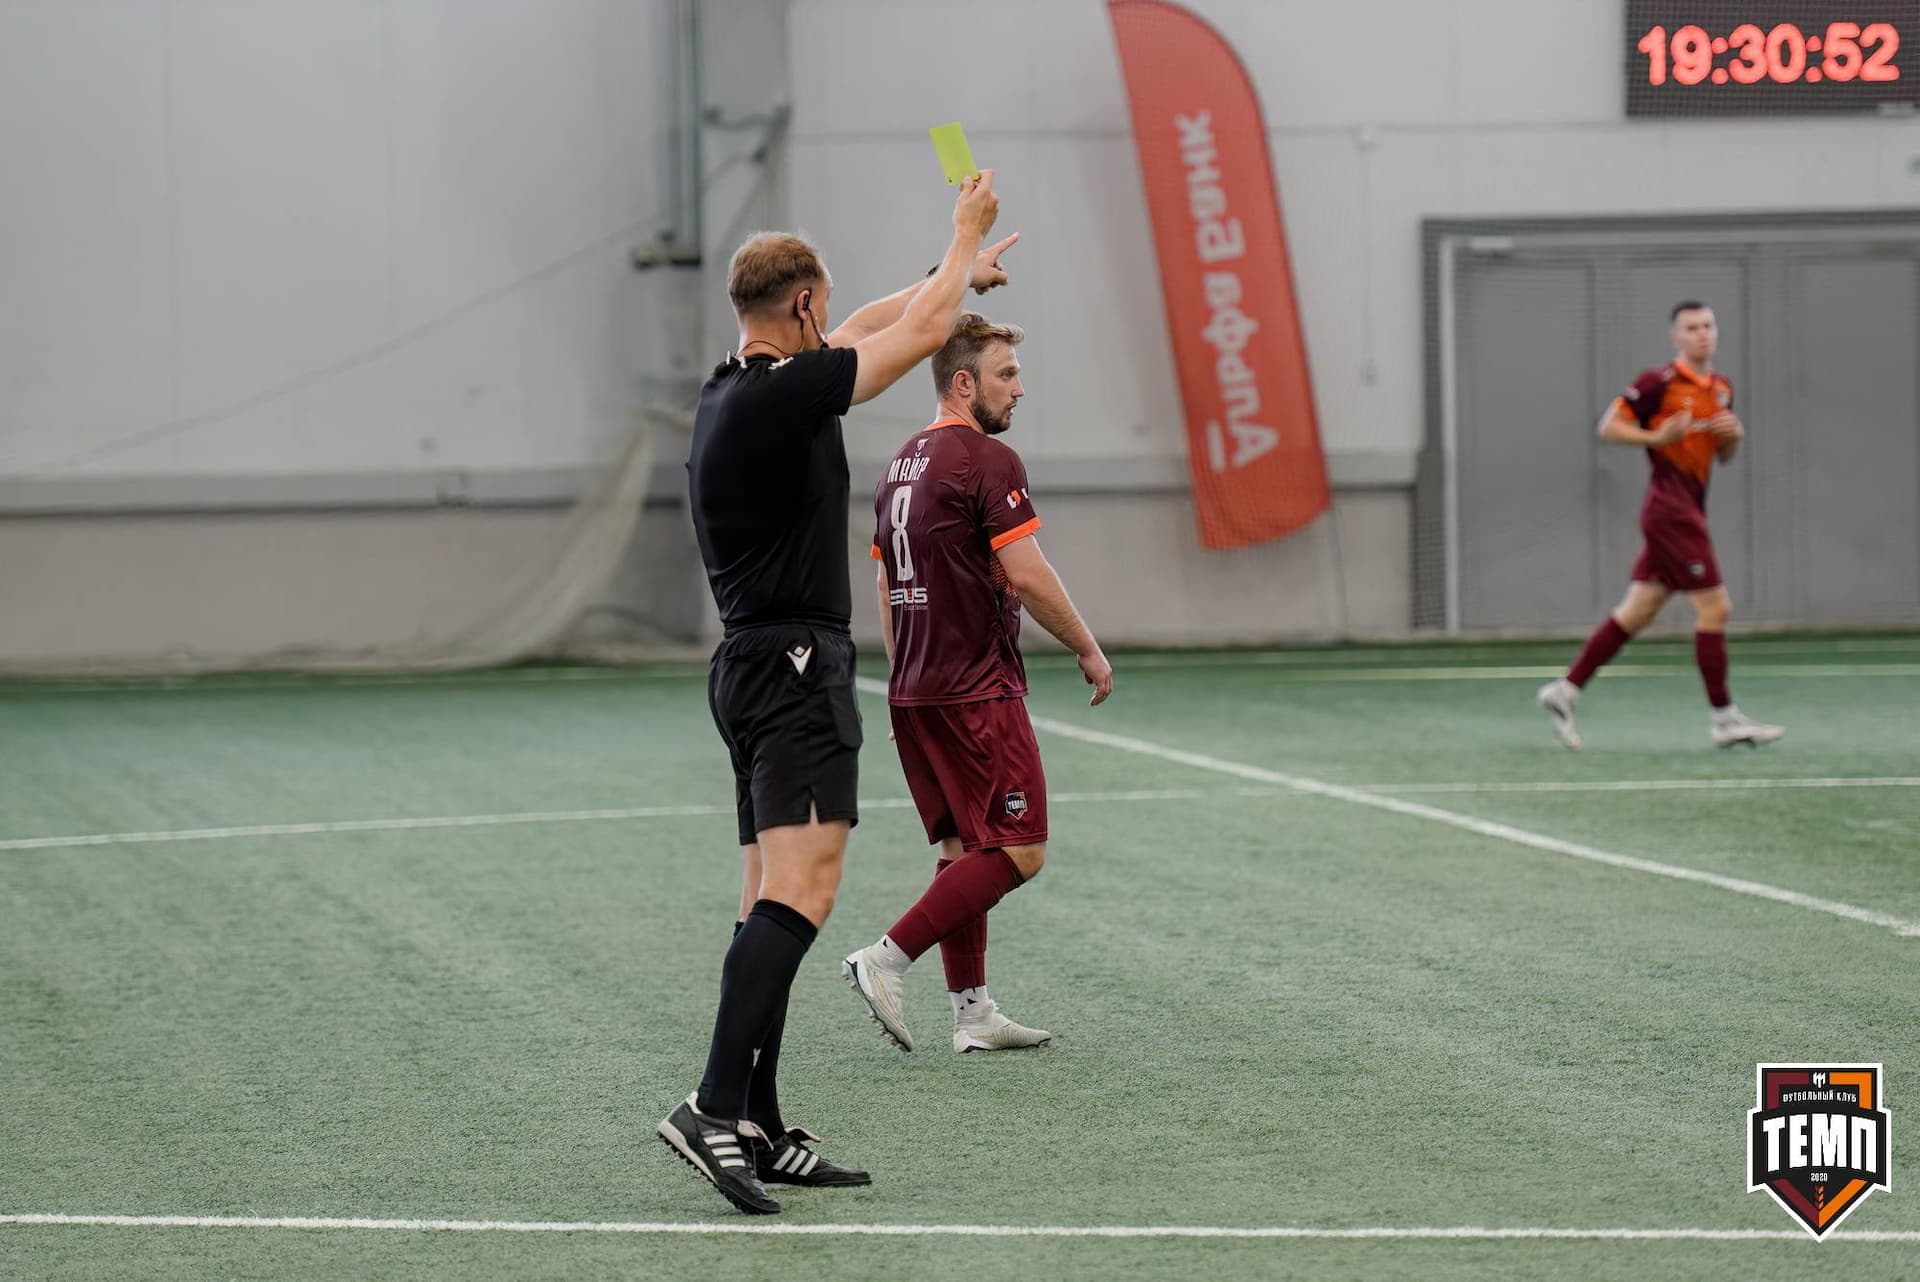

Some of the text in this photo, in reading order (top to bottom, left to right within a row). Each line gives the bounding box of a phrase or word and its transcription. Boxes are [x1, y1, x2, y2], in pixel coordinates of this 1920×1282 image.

[1637, 22, 1900, 86] 19:30:52
[887, 452, 930, 484] МАЙР
[891, 485, 914, 582] 8
